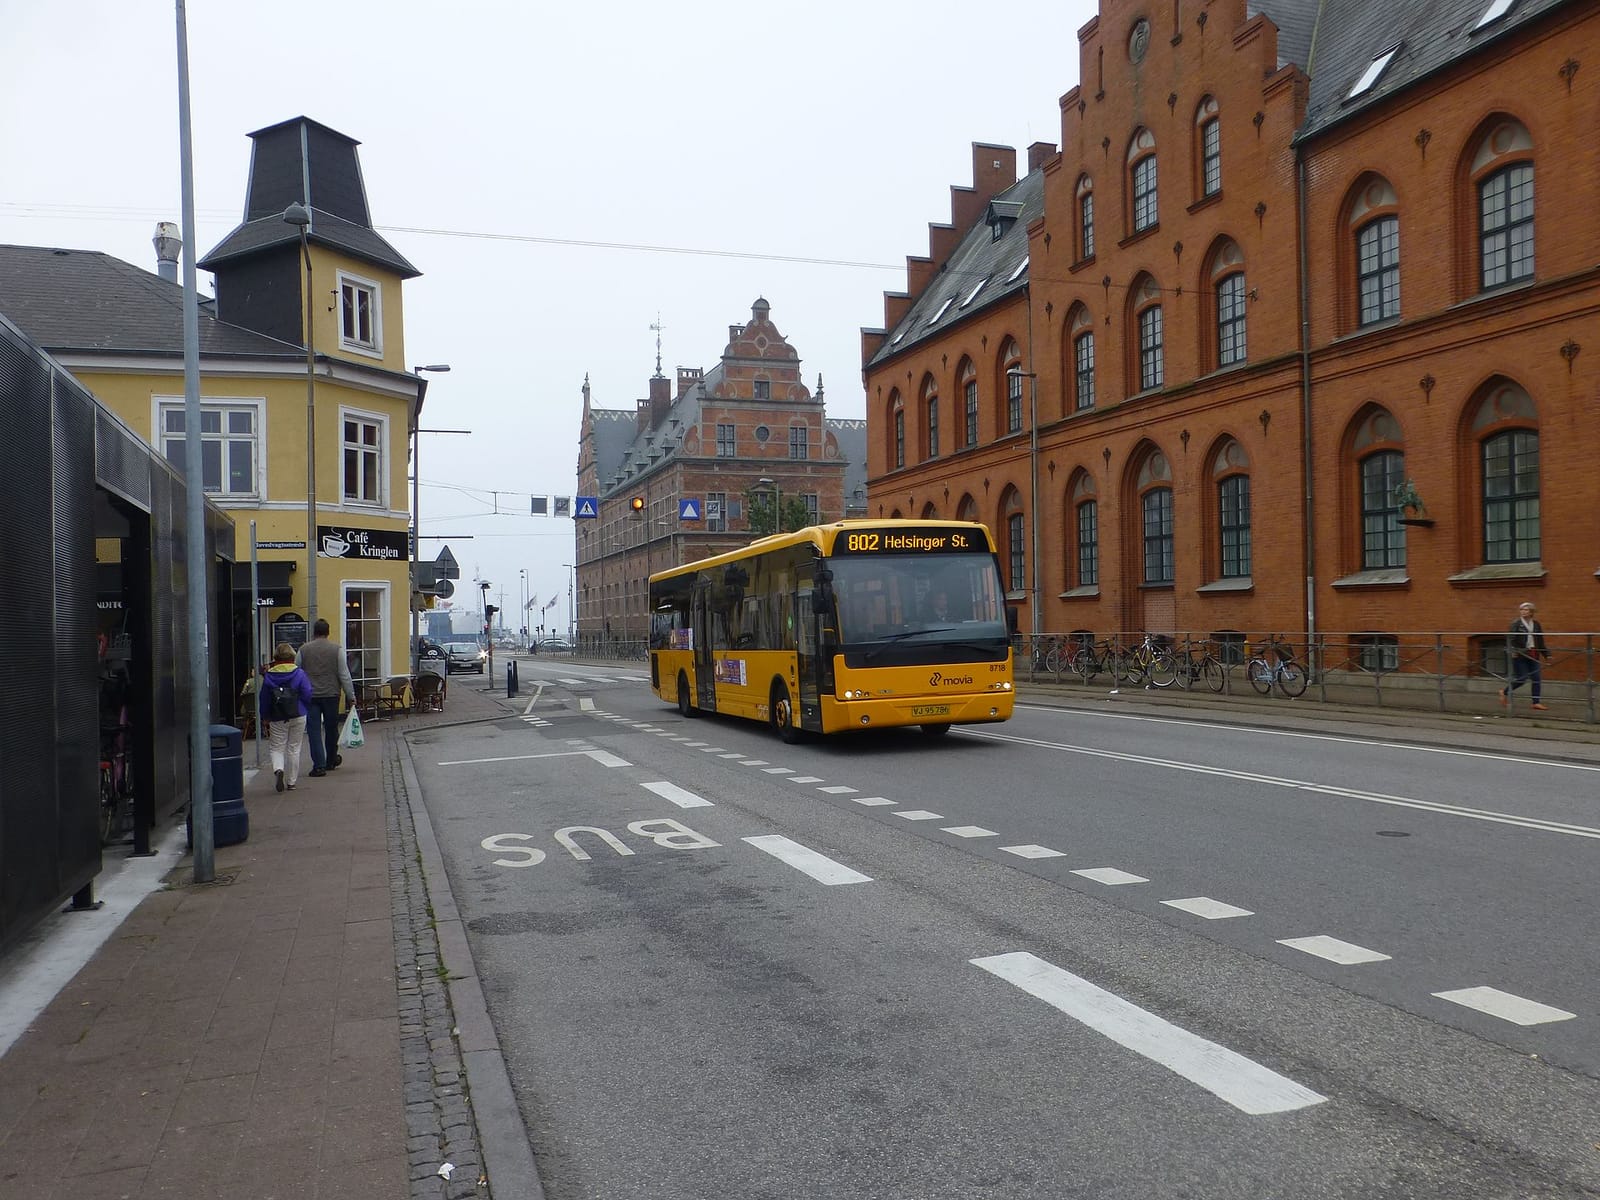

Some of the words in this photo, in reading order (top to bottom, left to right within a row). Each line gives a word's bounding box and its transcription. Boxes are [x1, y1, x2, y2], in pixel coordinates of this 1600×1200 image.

[346, 531, 369, 543] Café
[848, 534, 879, 551] 802
[884, 535, 946, 551] Helsingør
[951, 534, 969, 548] St.
[360, 544, 399, 560] Kringlen
[989, 664, 1006, 672] 8718
[943, 674, 973, 686] movia
[480, 818, 723, 868] BUS
